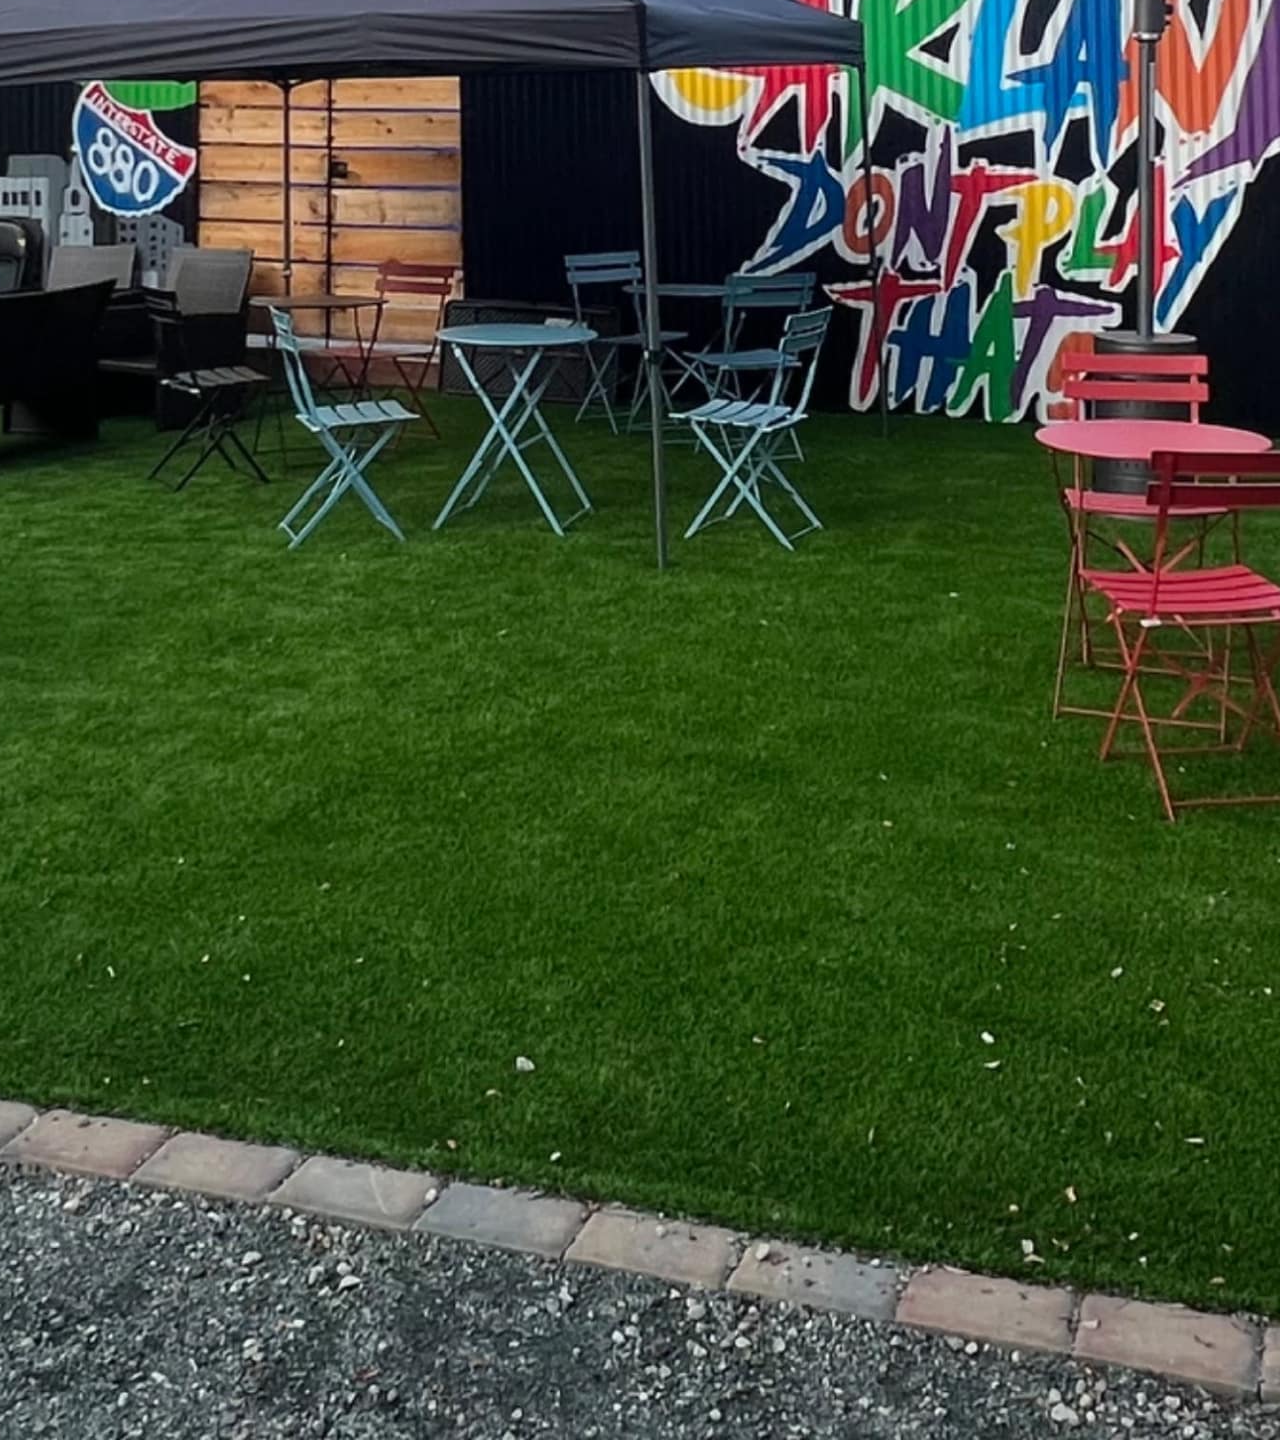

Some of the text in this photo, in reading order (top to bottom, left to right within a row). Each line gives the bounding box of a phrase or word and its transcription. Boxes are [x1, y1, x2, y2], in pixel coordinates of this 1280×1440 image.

[87, 127, 160, 202] 880
[89, 88, 178, 166] INTERSTATE
[742, 126, 1241, 332] DONT PLAY
